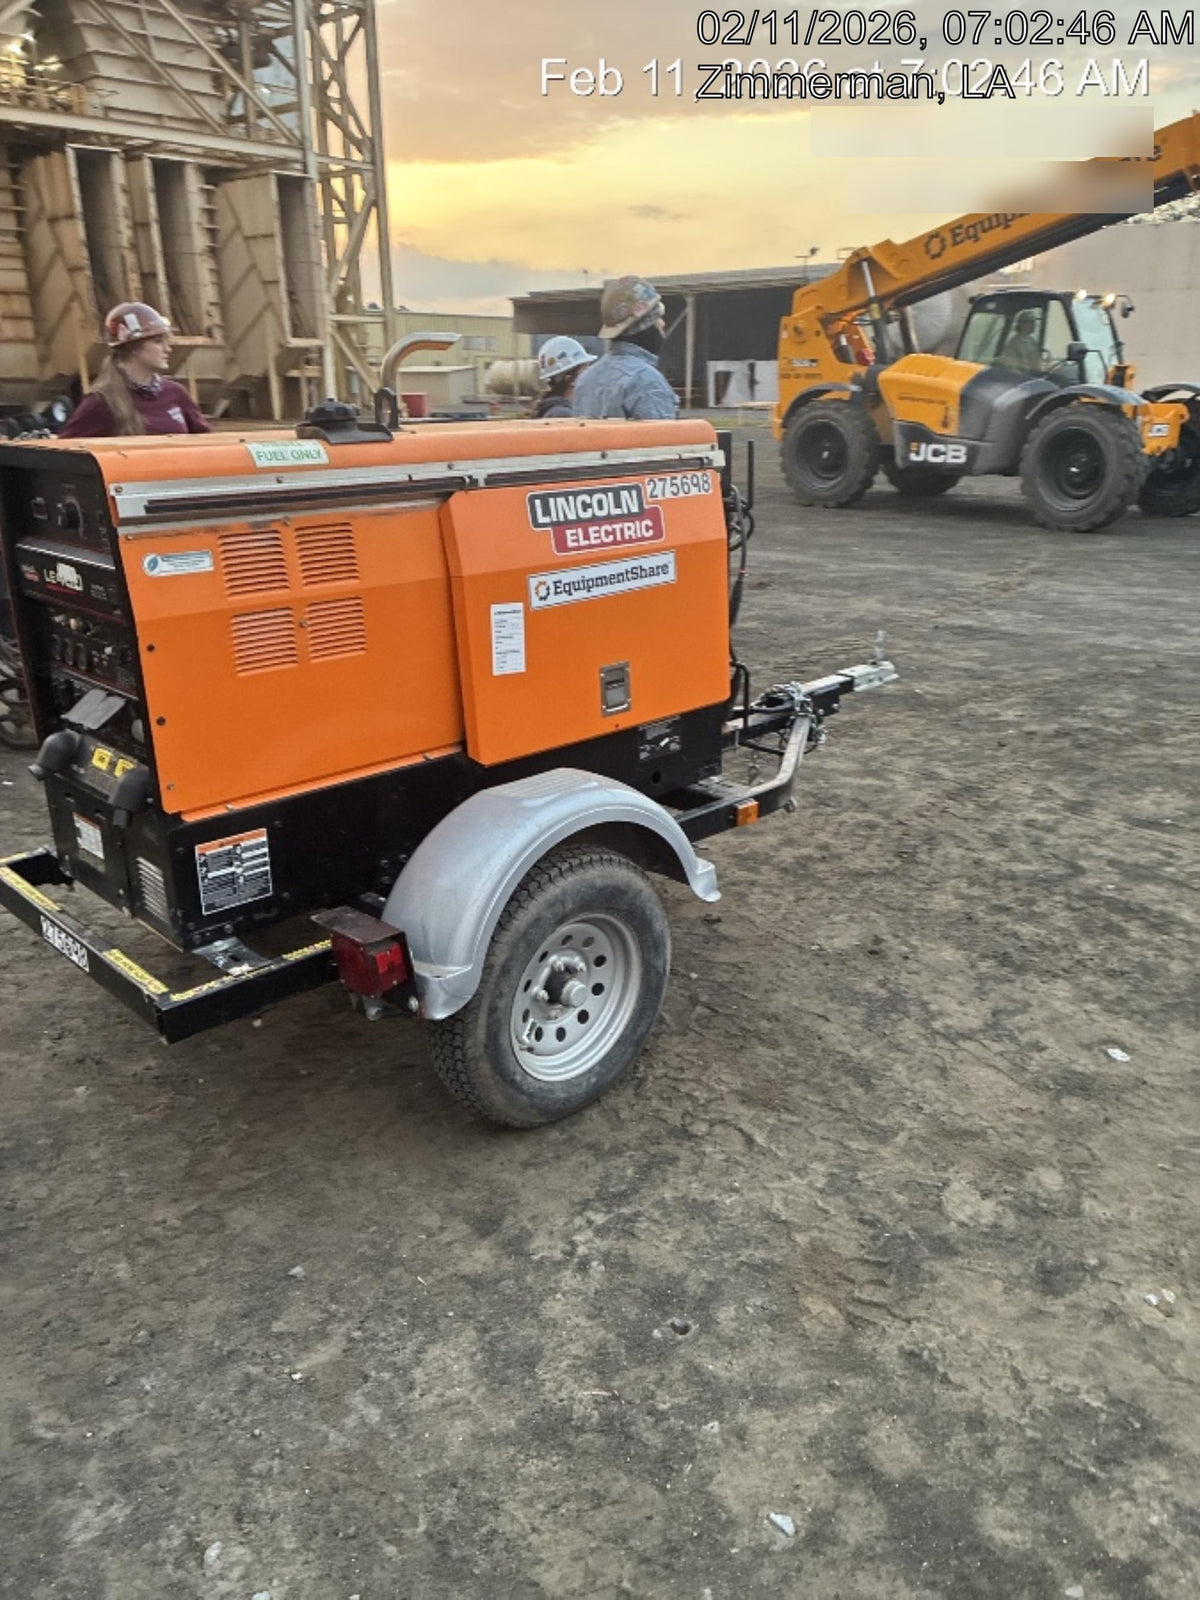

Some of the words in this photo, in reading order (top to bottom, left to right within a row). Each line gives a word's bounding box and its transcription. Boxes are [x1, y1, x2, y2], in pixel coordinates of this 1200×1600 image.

[255, 450, 285, 462] FUEL
[290, 447, 321, 460] ONLY
[909, 442, 967, 464] JCB
[647, 473, 712, 499] 275698
[534, 488, 640, 524] LINCOLN
[565, 519, 654, 548] ELECTRIC
[553, 563, 670, 597] EquipmentShare
